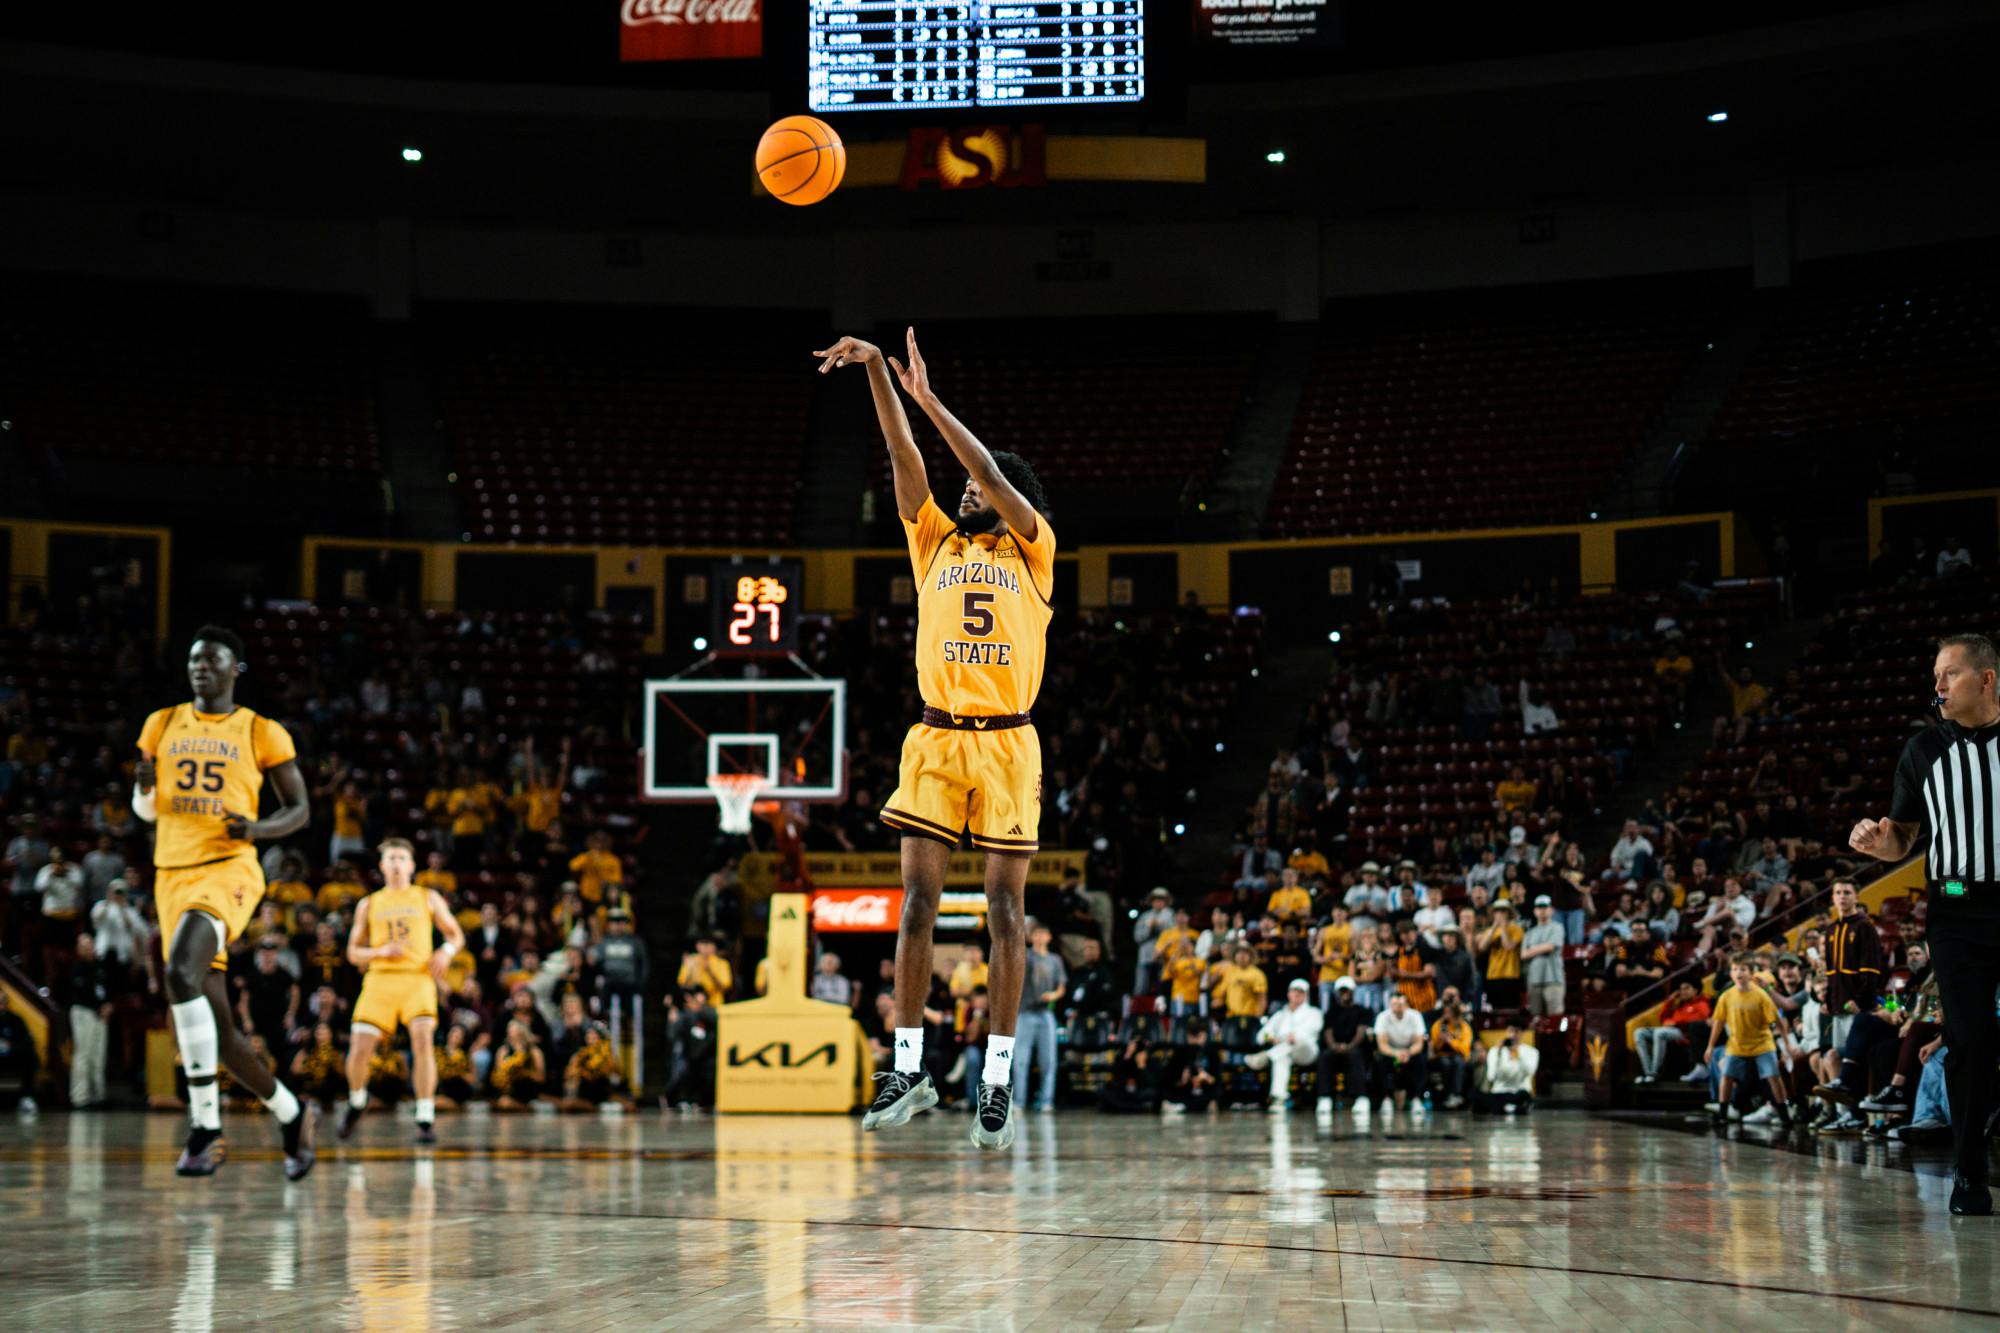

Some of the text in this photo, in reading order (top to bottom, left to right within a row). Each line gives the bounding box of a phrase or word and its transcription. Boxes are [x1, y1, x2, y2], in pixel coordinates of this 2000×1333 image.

[903, 124, 1047, 192] ASU
[936, 562, 1020, 595] ARIZONA
[729, 602, 780, 645] 27
[961, 591, 995, 637] 5
[943, 641, 1012, 667] STATE
[168, 736, 240, 762] ARIZONA
[175, 758, 227, 793] 35
[171, 795, 224, 816] STATE
[727, 1041, 838, 1068] KIA
